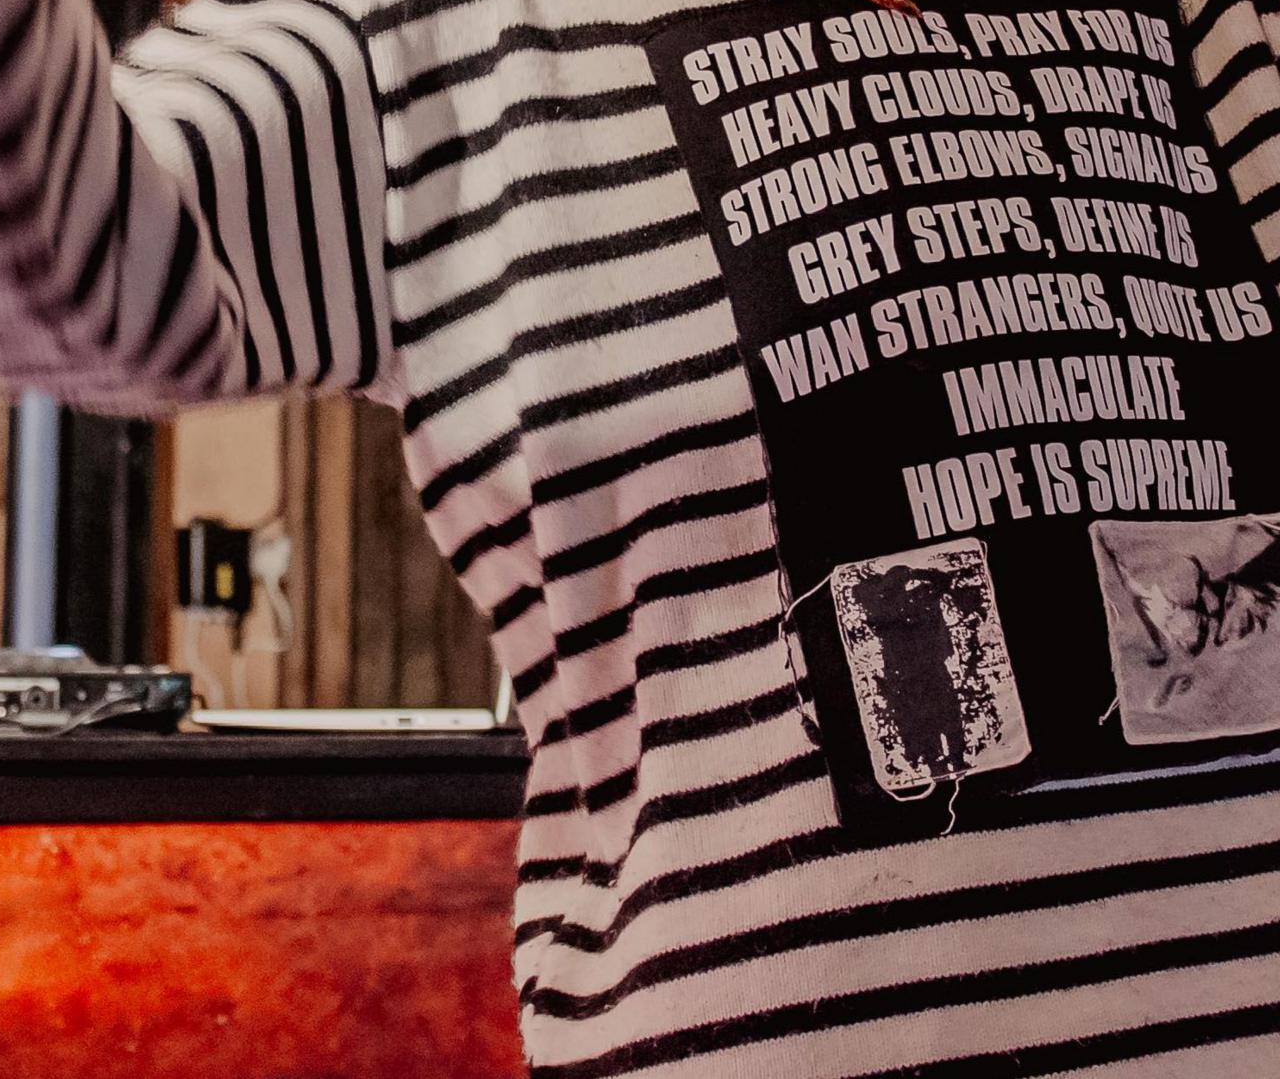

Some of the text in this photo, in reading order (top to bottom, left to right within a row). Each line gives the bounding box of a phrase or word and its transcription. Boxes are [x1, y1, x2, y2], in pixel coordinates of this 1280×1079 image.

[682, 8, 1175, 106] STRAY SOULS, PRAY FOR US
[721, 66, 1177, 168] HEAVY CLOUDS, DRAPE US
[720, 126, 1218, 247] STRONG ELBOWS, SIGNAL US
[787, 196, 1199, 305] GREY STEPS, DEFINE US
[760, 273, 1273, 403] WAN STRANGERS, QUOTE US
[942, 355, 1186, 436] IMMACULATE
[902, 439, 1236, 540] HOPE IS SUPREME
